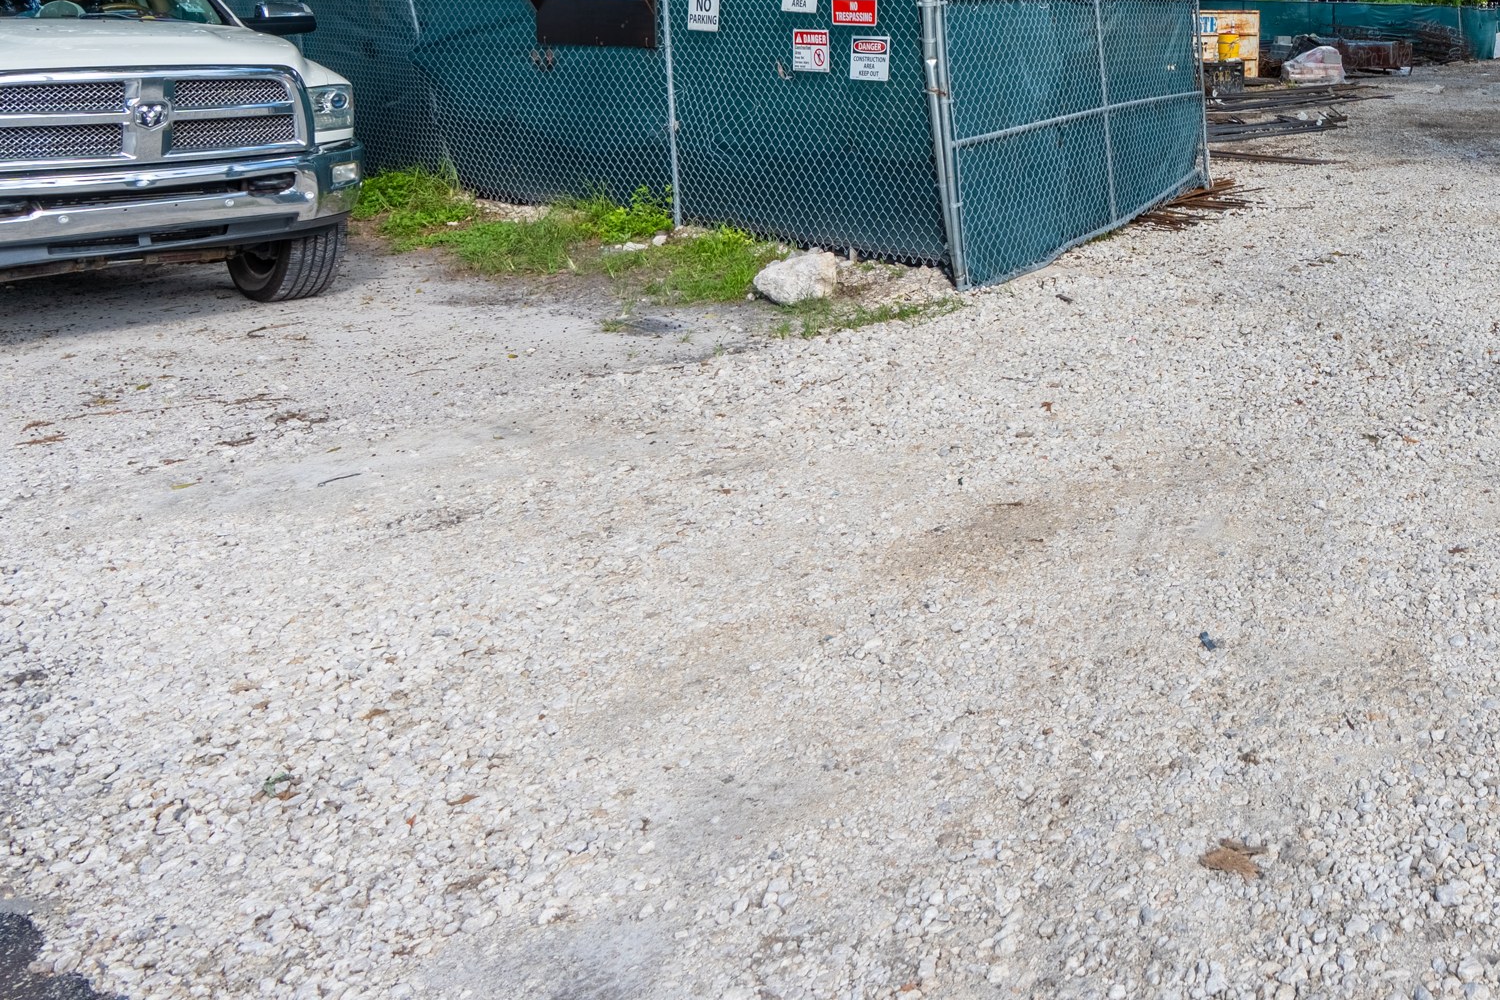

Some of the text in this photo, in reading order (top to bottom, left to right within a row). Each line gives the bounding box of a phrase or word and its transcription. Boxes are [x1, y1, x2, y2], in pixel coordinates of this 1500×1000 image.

[791, 0, 807, 8] AREA
[849, 1, 858, 11] NO
[688, 13, 717, 25] PARKING
[835, 12, 873, 22] TRESPASSING
[802, 33, 827, 44] DANGER
[857, 42, 882, 51] DANGER
[853, 55, 886, 63] CONSTRUCTION
